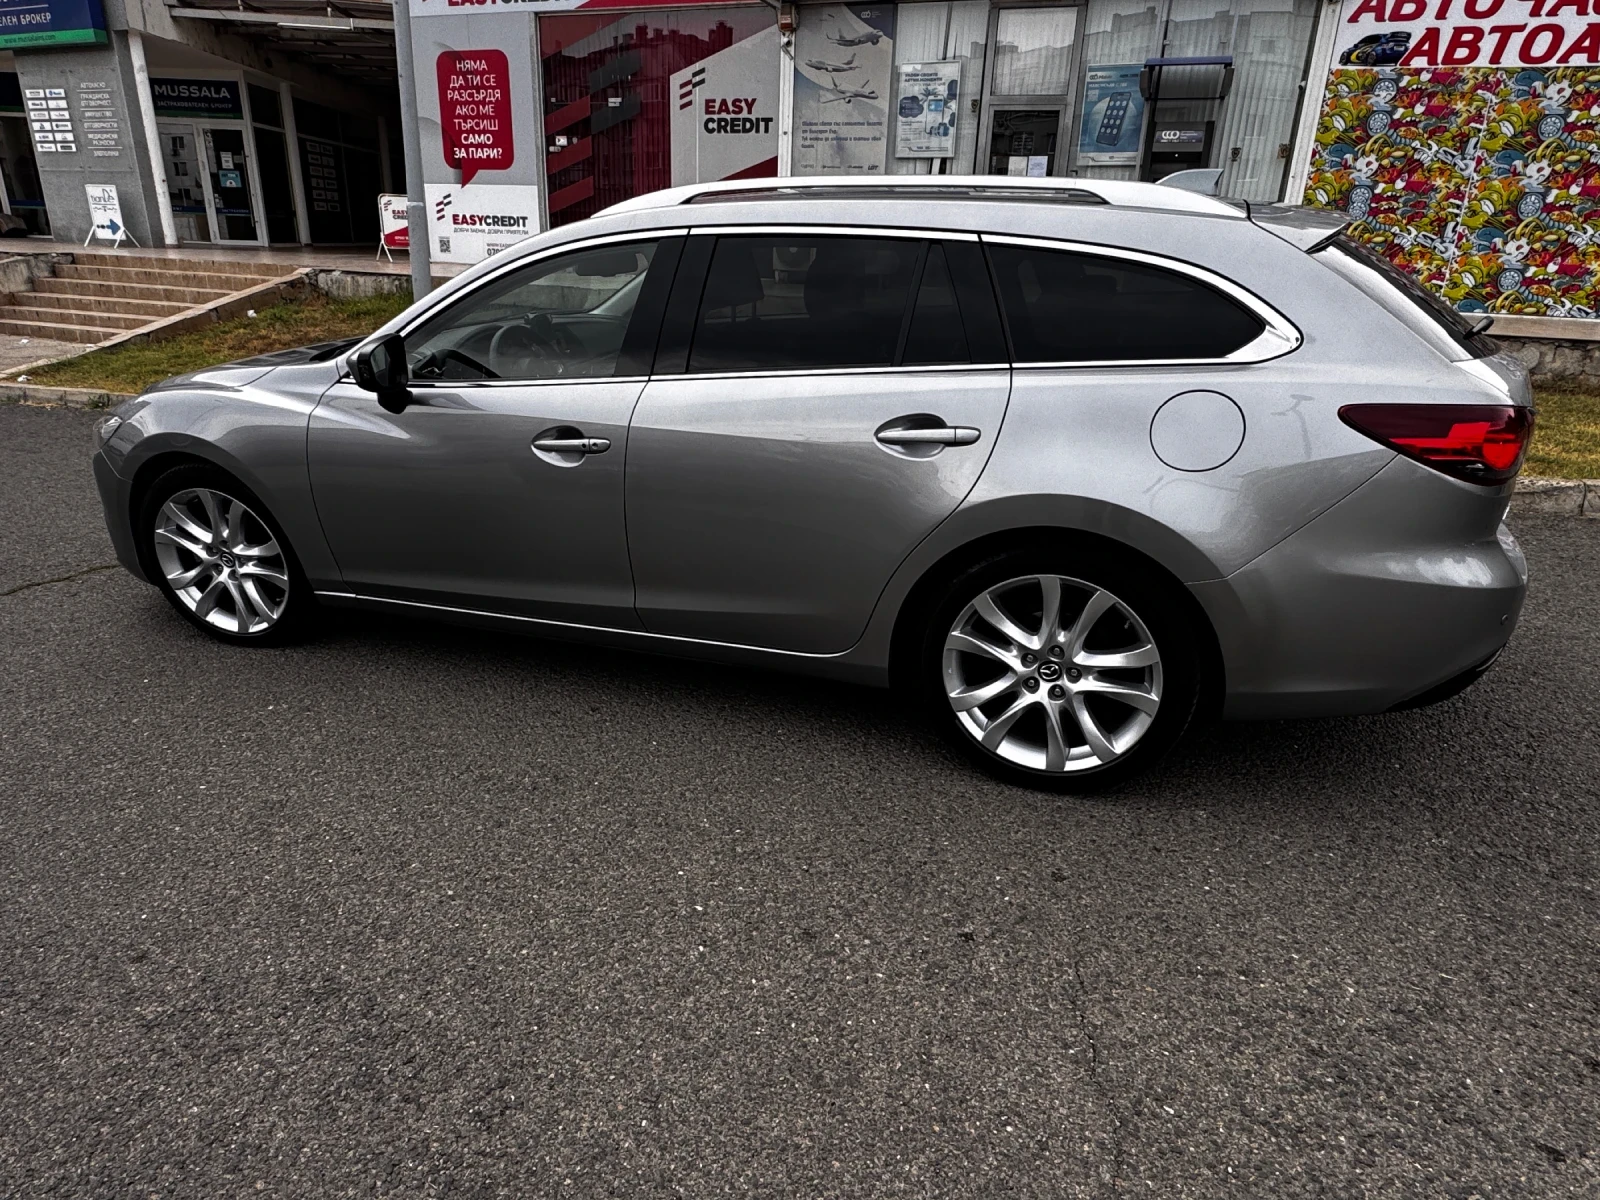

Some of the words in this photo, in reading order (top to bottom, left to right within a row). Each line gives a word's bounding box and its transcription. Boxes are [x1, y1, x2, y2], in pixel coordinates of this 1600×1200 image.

[20, 12, 52, 25] БРОКЕР
[1399, 23, 1600, 66] АВТОА
[456, 60, 488, 71] НЯМА
[449, 75, 466, 89] ДА
[467, 75, 480, 86] ТИ
[483, 74, 497, 86] СЕ
[154, 84, 231, 98] MUSSALA
[447, 89, 501, 103] РАЗСЪРДЯ
[455, 104, 477, 116] АКО
[480, 104, 495, 116] МЕ
[704, 98, 757, 115] EASY
[453, 119, 499, 131] ТЪРСИШ
[704, 117, 773, 134] CREDIT
[461, 133, 494, 145] САМО
[453, 148, 467, 159] ЗА
[469, 147, 503, 159] ПАРИ?
[452, 214, 528, 228] EASYCREDIT
